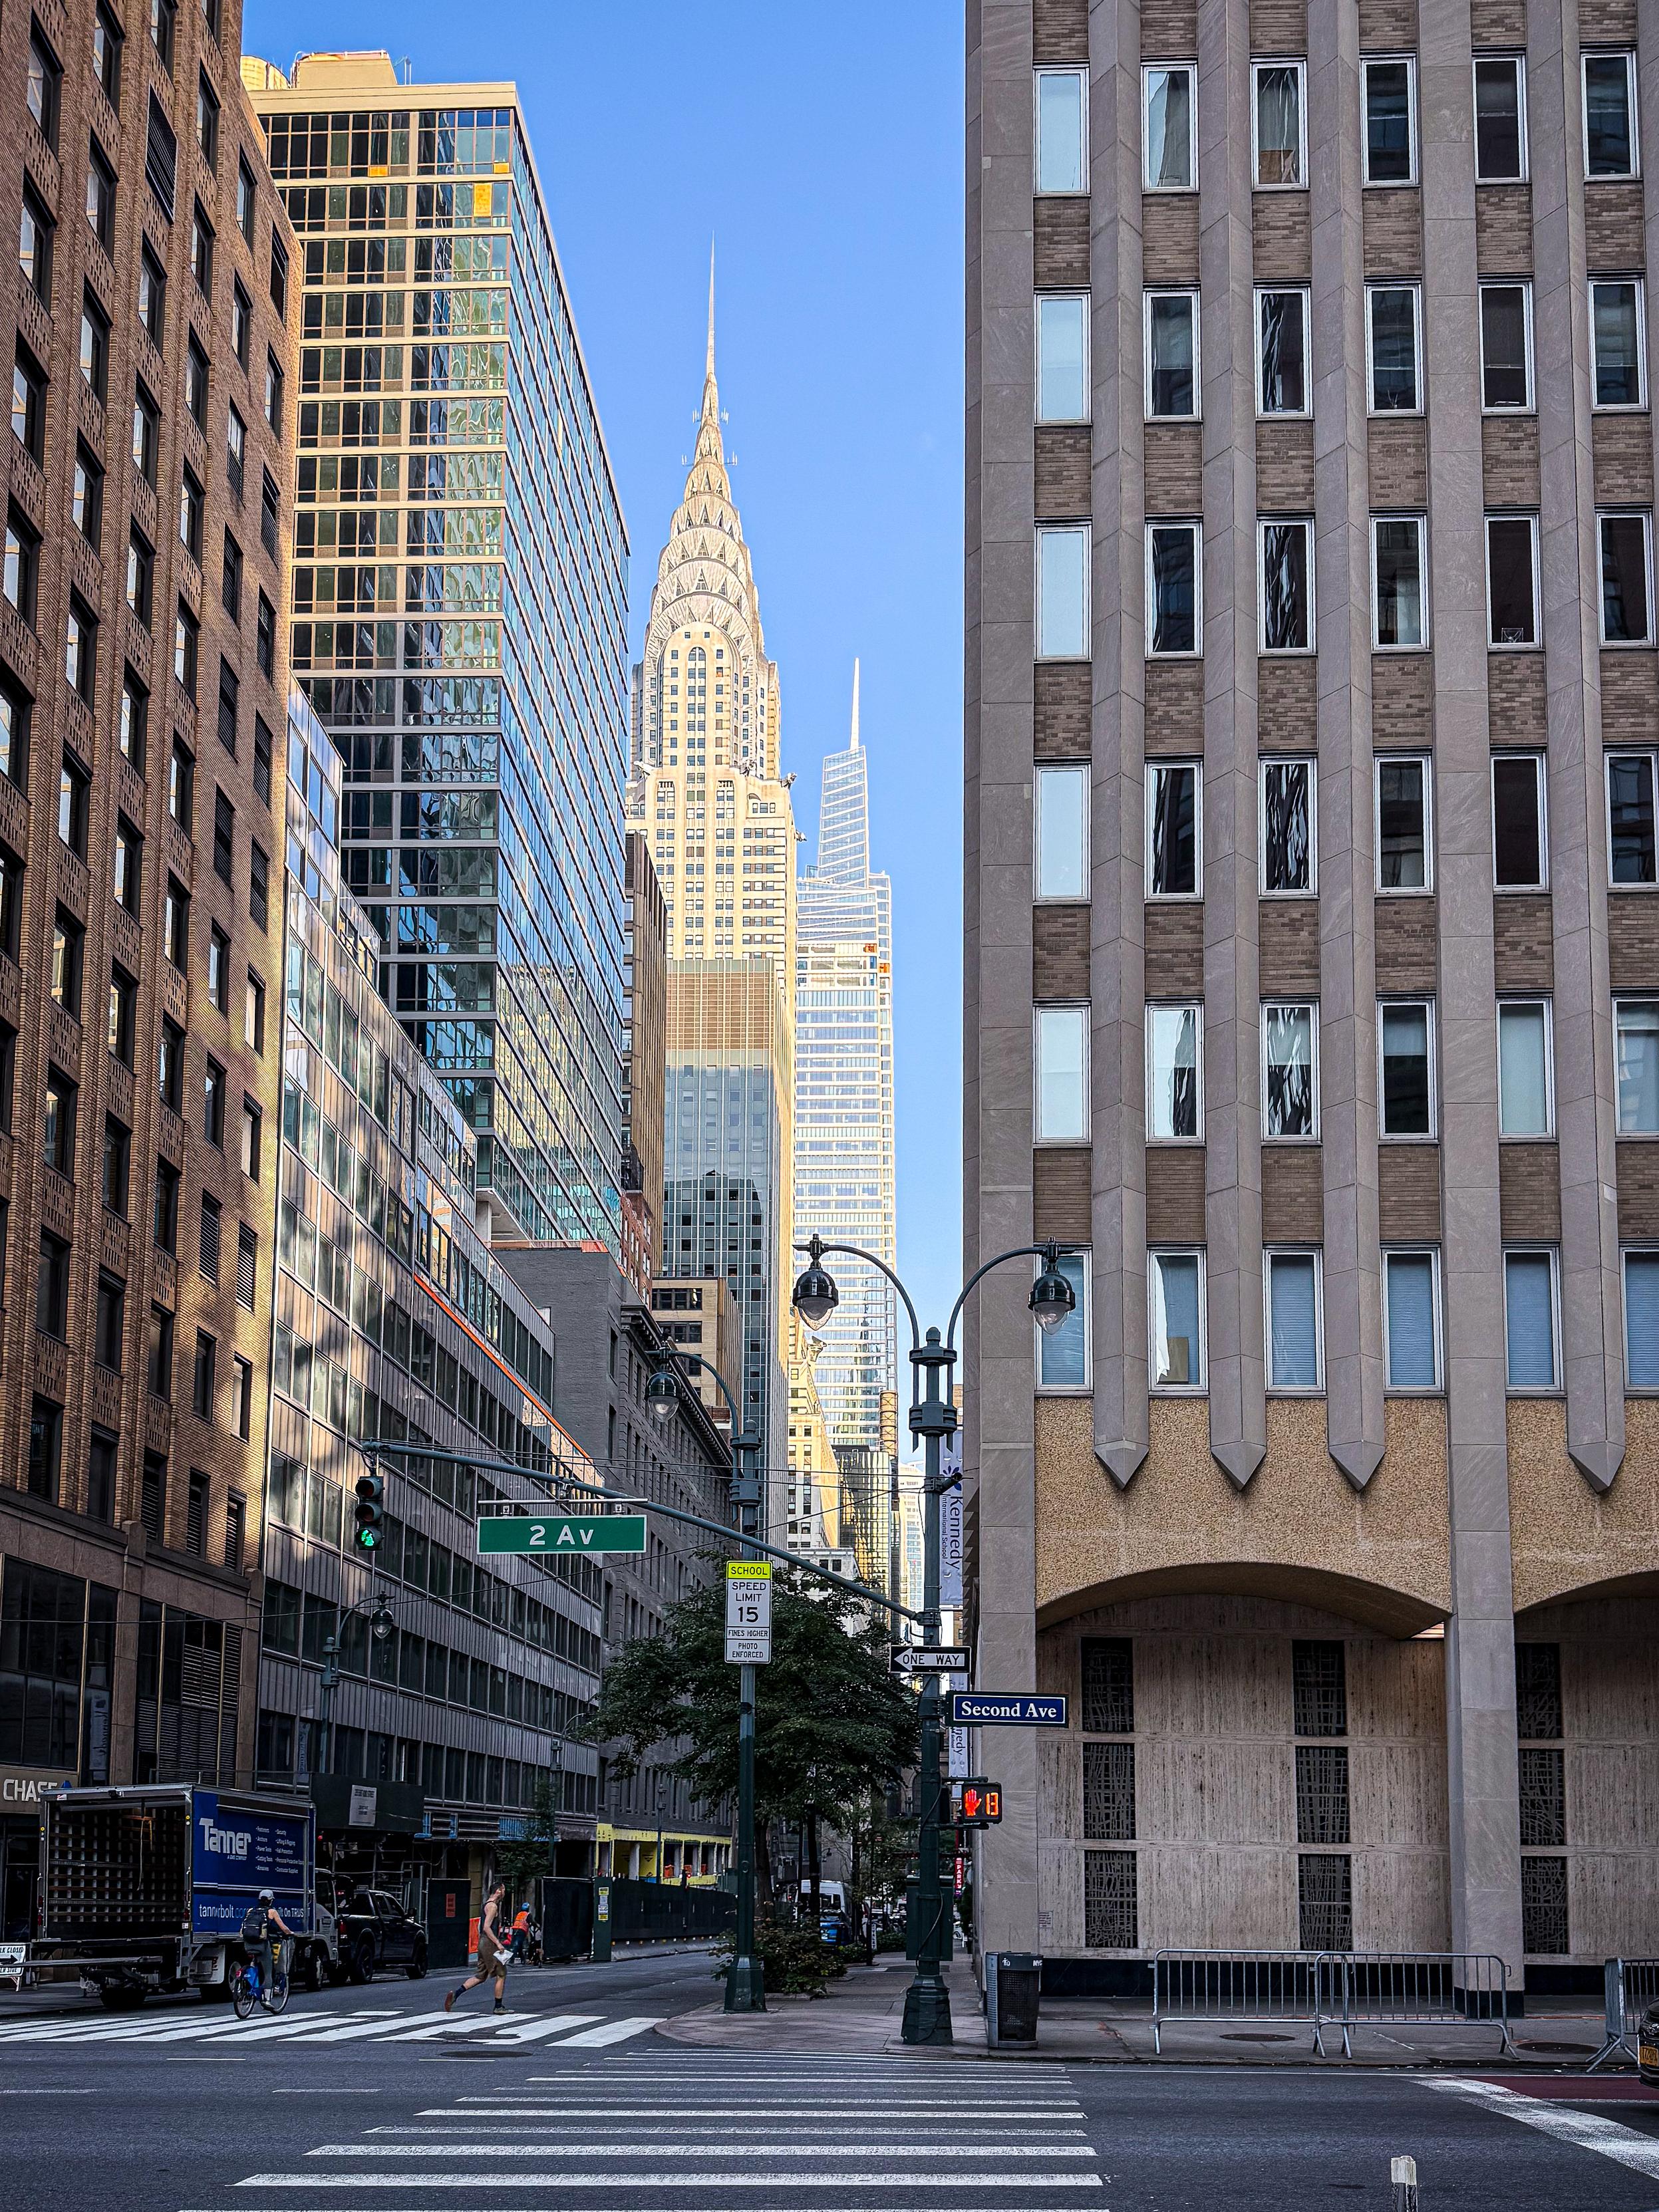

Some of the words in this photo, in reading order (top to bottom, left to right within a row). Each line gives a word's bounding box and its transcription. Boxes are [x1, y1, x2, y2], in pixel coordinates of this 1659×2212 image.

[529, 1525, 545, 1545] 2
[556, 1525, 594, 1545] Av
[945, 1496, 963, 1570] Kennedy
[731, 1566, 768, 1576] SCHOOL
[732, 1582, 766, 1591] SPEED
[736, 1593, 762, 1602] LIMIT
[738, 1606, 759, 1623] 15
[902, 1654, 925, 1665] ONE
[936, 1655, 960, 1665] WAY
[961, 1701, 1021, 1717] Second
[1025, 1703, 1057, 1718] Ave
[953, 1727, 966, 1755] nedy
[199, 1818, 251, 1855] Tanner
